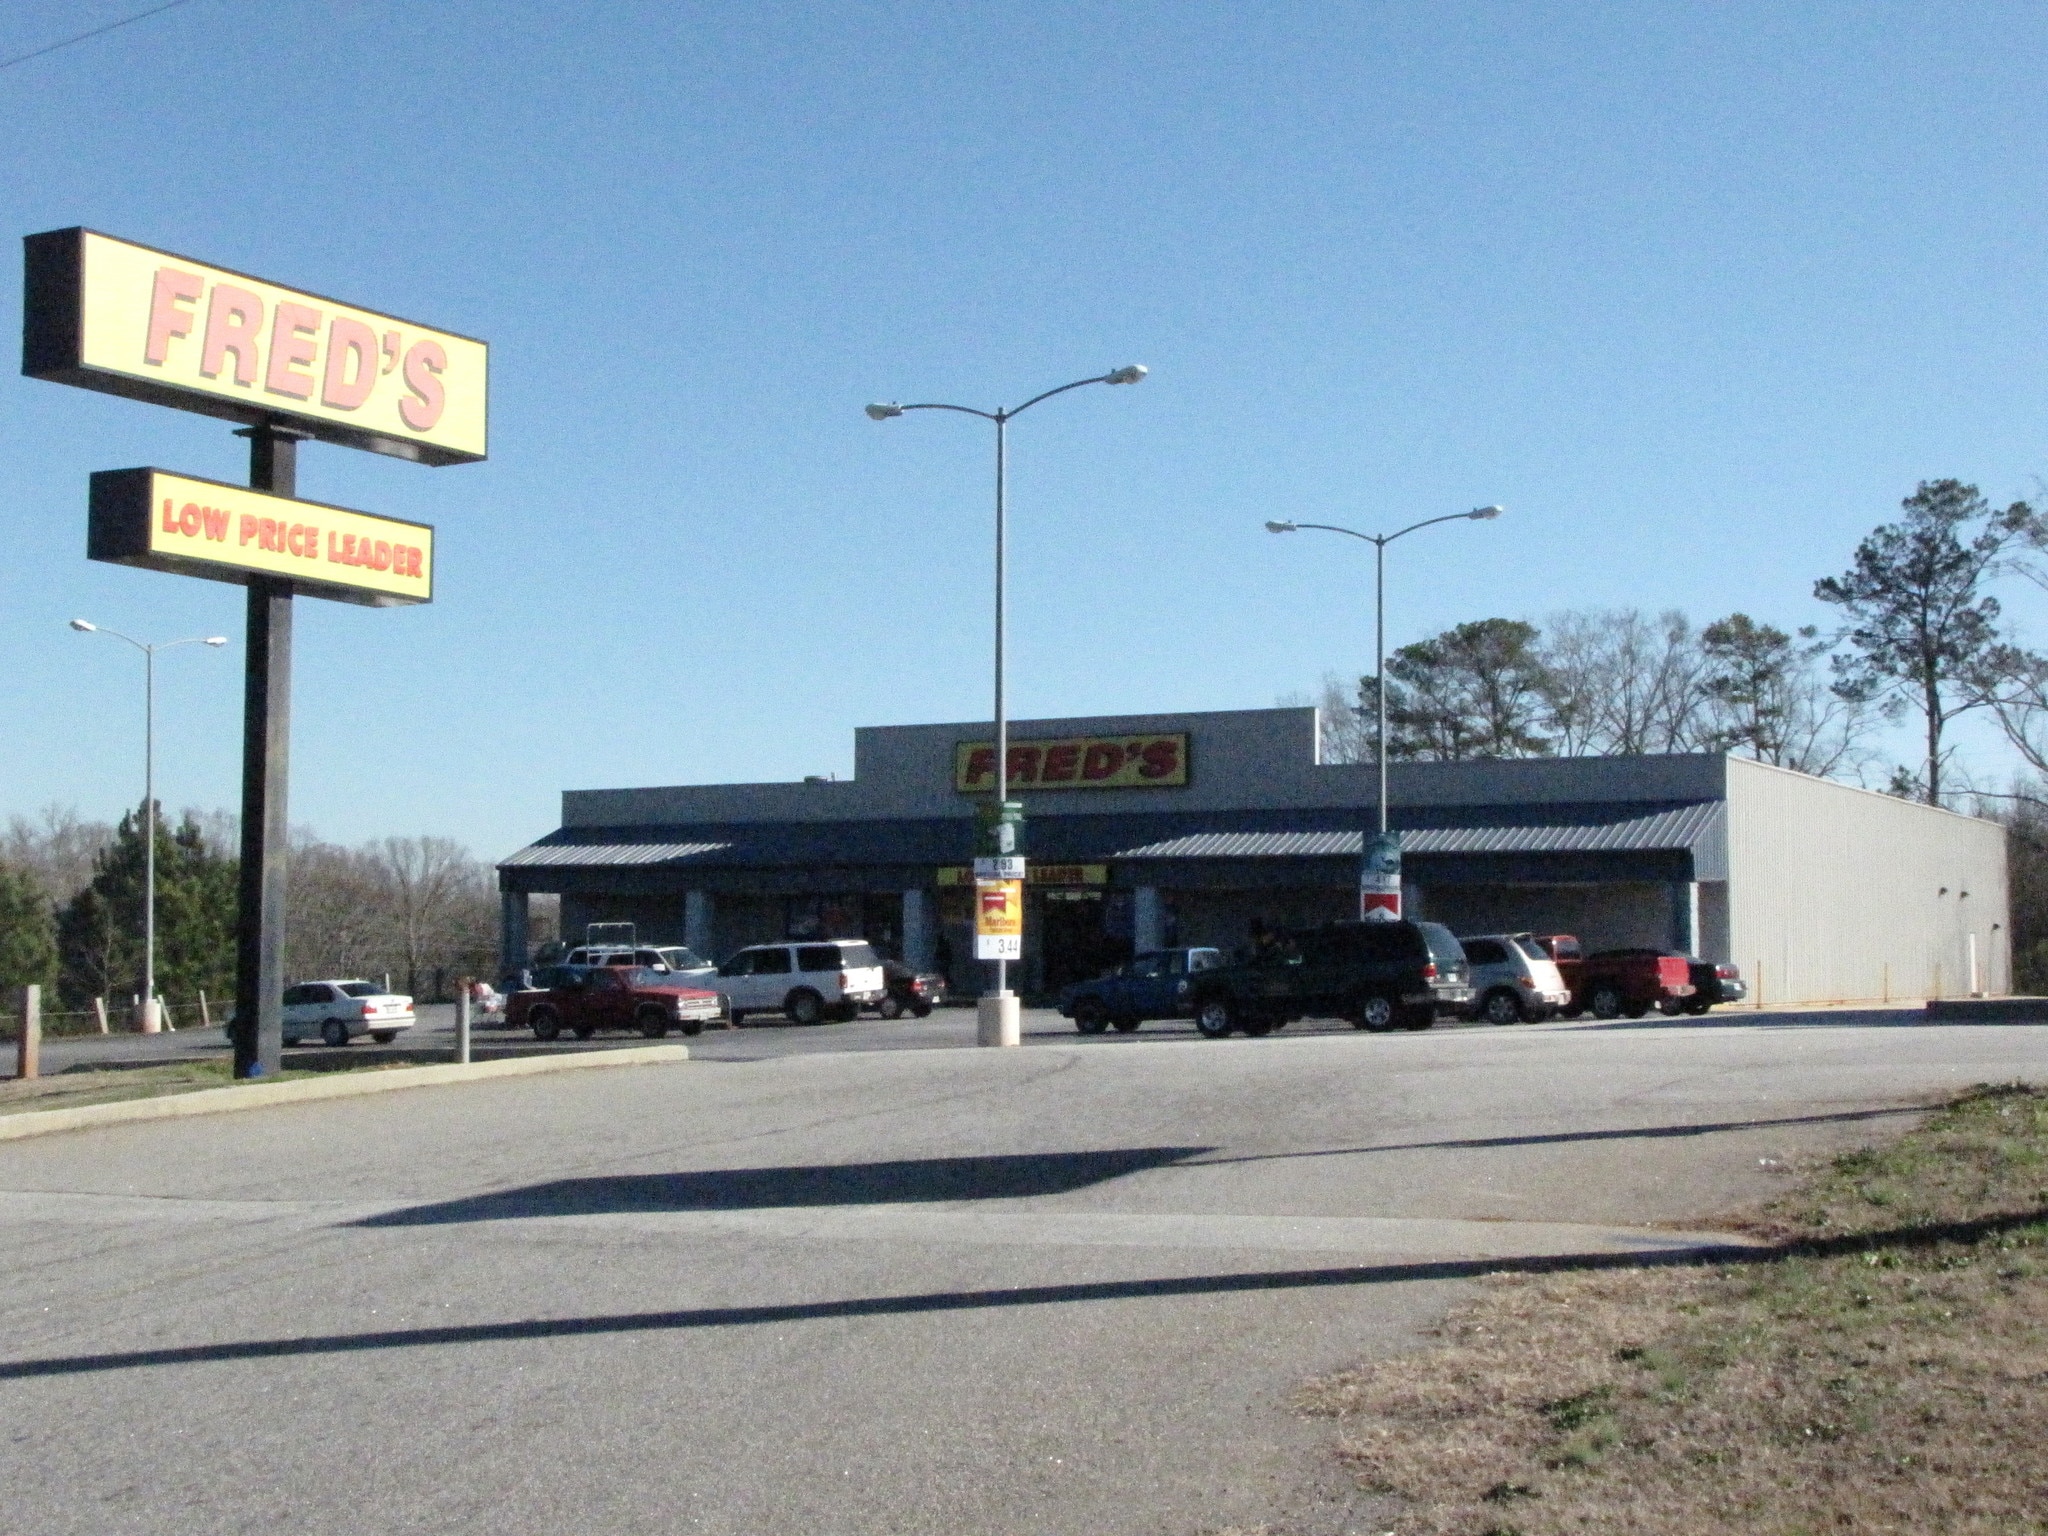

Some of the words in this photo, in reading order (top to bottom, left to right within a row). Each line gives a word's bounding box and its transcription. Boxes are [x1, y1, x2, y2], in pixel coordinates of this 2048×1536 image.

[144, 267, 448, 432] FRED'S
[162, 499, 232, 541] LOW
[239, 514, 319, 559] PRICE
[327, 530, 423, 578] LEADER
[966, 741, 1178, 784] FRED'S
